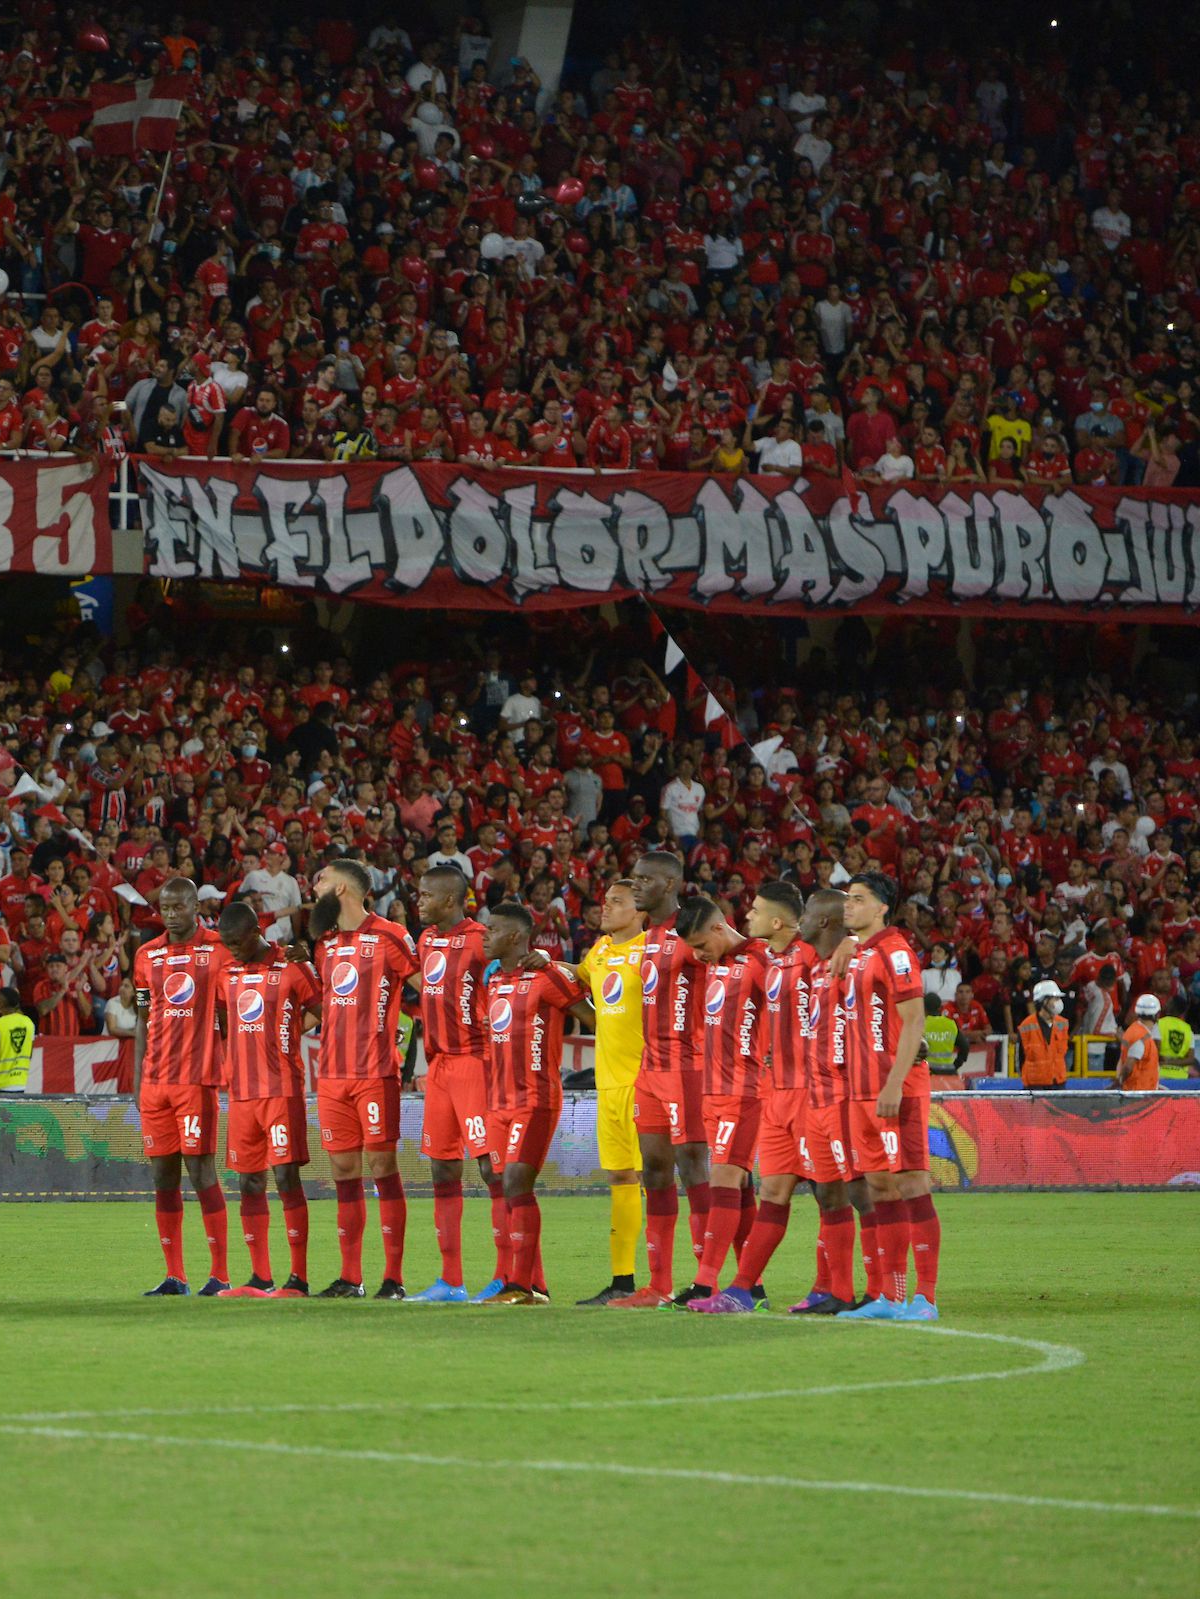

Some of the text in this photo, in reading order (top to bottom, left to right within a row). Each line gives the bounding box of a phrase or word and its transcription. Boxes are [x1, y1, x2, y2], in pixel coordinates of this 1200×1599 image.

[138, 460, 241, 578] EN
[253, 472, 374, 594] EL
[377, 464, 674, 602] DOLOR
[886, 488, 1108, 603] PURO
[330, 996, 357, 1007] pepsi
[422, 985, 444, 995] pepsi
[460, 983, 475, 1026] BetPlay
[163, 1007, 194, 1019] pepsi
[377, 989, 391, 1033] BetPlay
[673, 985, 689, 1032] BetPlay
[796, 991, 811, 1037] BetPlay
[238, 1022, 265, 1033] pepsi
[280, 1011, 293, 1054] BetPlay
[739, 1010, 757, 1056] BetPlay
[832, 1016, 847, 1065] BetPlay
[870, 1006, 885, 1052] BetPlay
[530, 1028, 545, 1072] BetPlay
[183, 1115, 201, 1138] 14
[367, 1102, 380, 1124] 9
[465, 1116, 487, 1141] 28
[669, 1103, 679, 1126] 3
[270, 1124, 289, 1147] 16
[509, 1123, 523, 1144] 5
